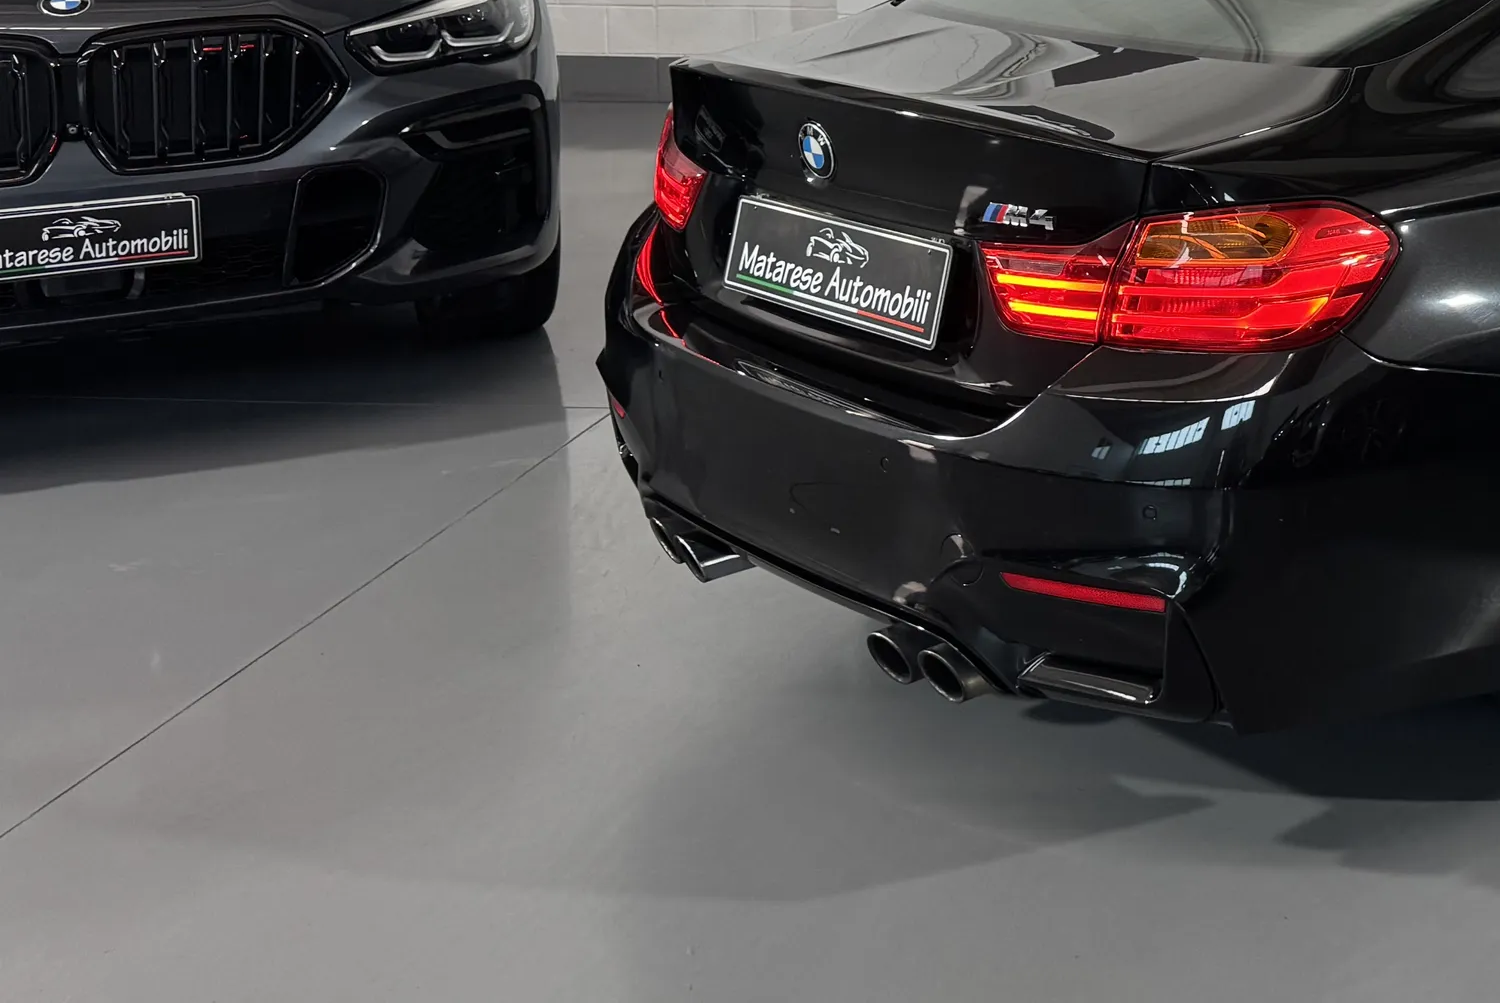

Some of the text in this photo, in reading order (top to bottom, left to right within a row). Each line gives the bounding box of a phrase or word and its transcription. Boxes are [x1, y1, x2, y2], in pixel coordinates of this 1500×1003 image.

[1003, 203, 1054, 231] M4
[0, 228, 189, 270] tarese Automobili
[738, 241, 932, 325] Matarese Automobili
